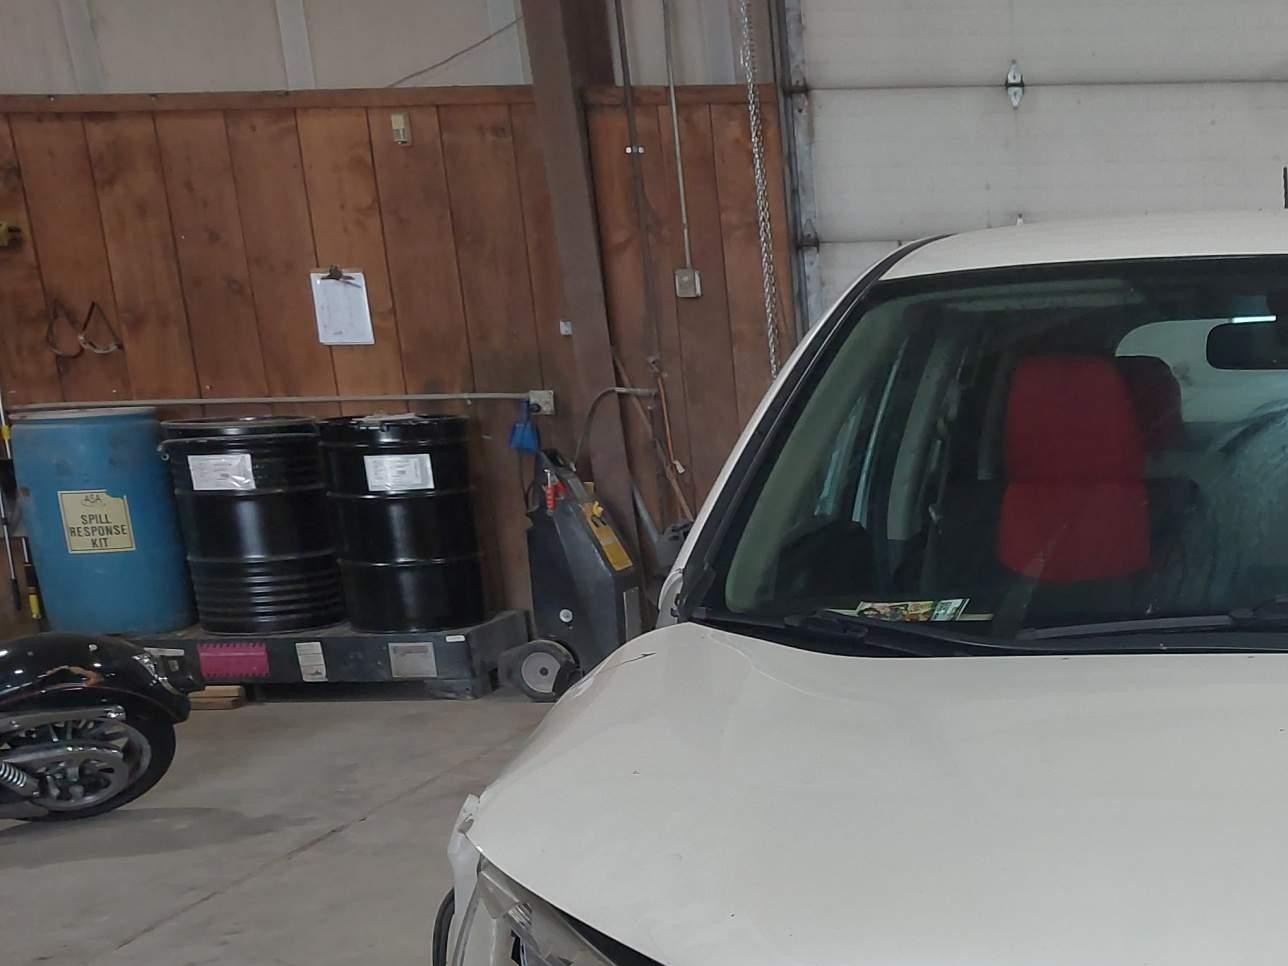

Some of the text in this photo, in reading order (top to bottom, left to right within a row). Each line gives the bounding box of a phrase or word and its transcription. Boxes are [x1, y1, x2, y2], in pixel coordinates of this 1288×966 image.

[80, 513, 112, 525] SPILL
[69, 524, 128, 537] RESPONSE
[91, 537, 109, 548] KIT
